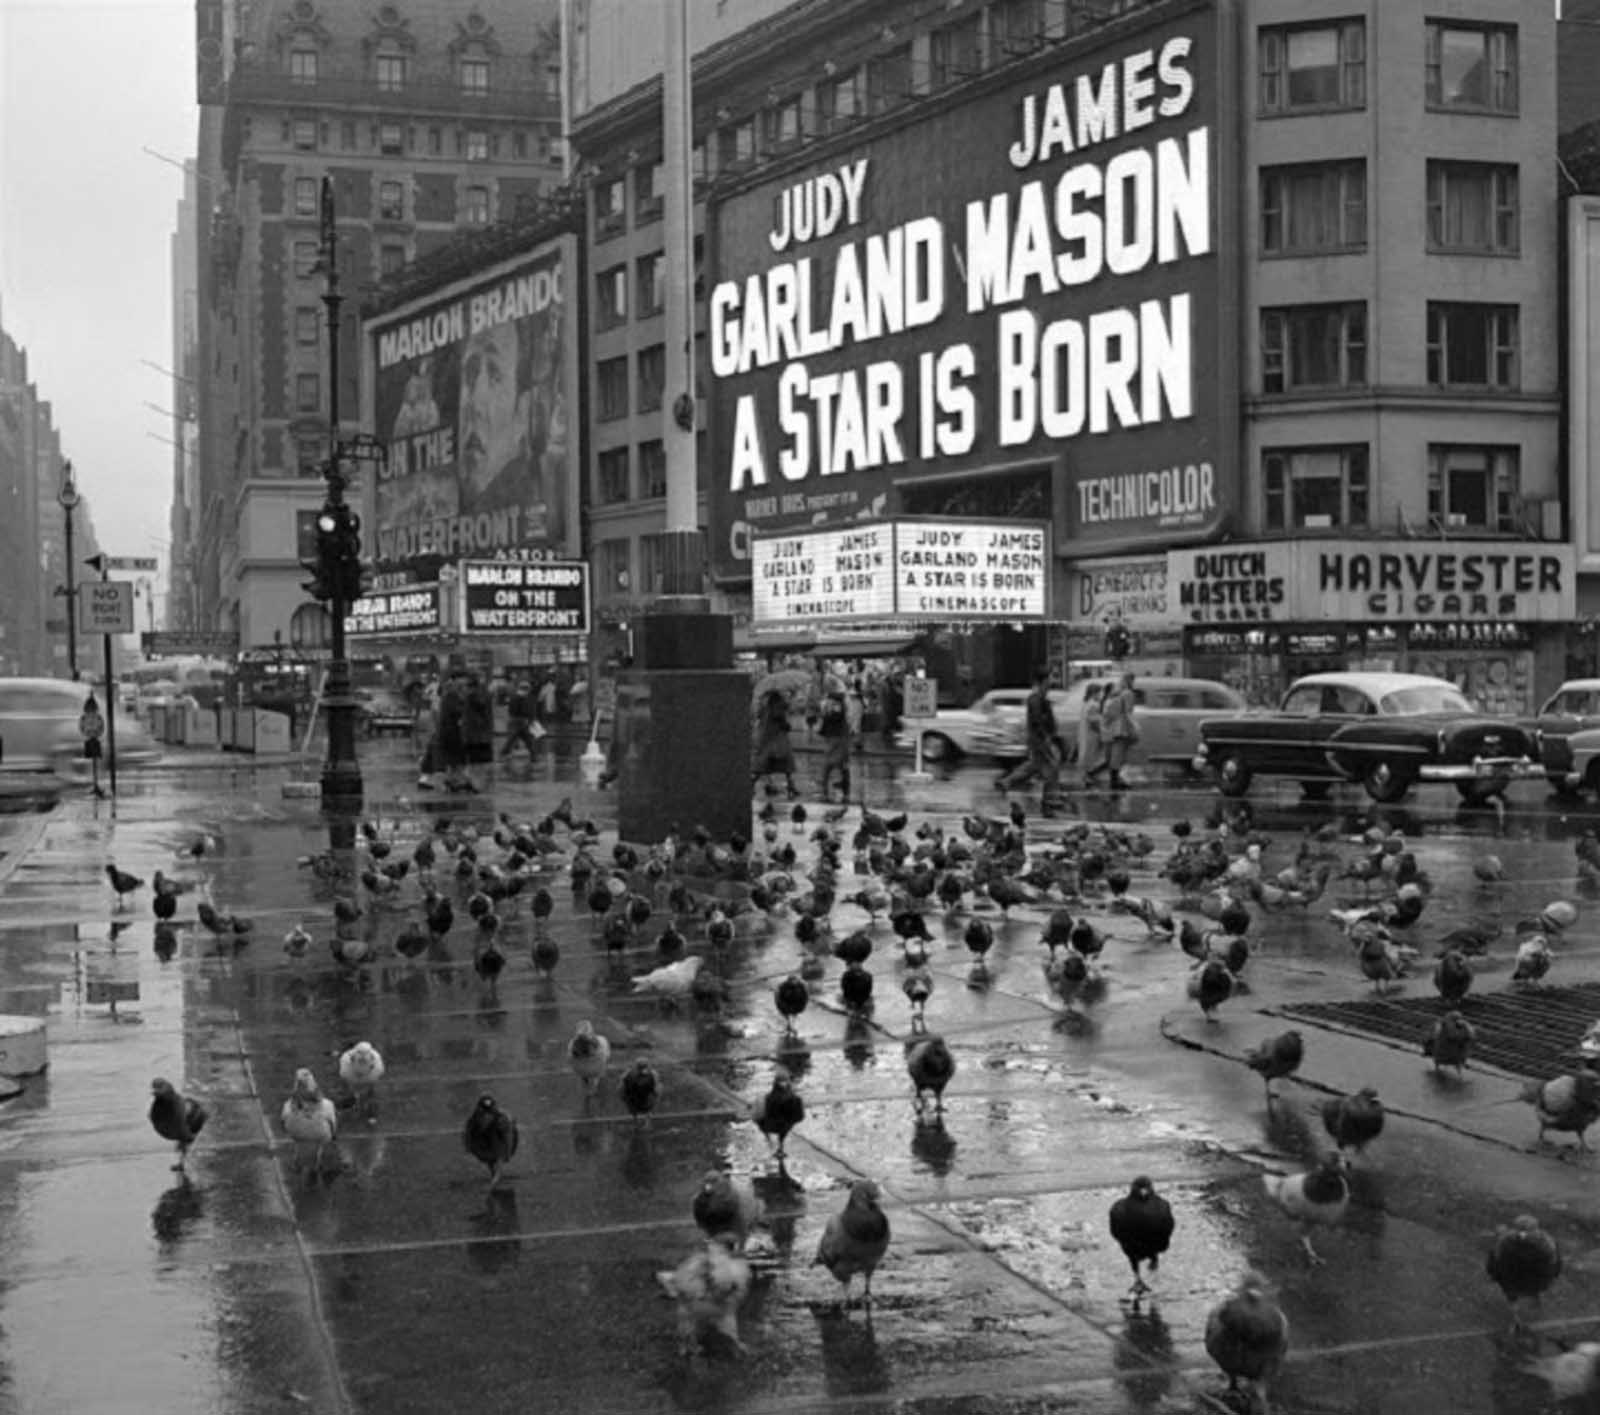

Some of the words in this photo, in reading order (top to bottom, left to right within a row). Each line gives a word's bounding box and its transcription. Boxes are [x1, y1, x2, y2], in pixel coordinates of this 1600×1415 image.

[1010, 37, 1192, 168] JAMES
[769, 159, 868, 251] JUDY
[710, 216, 944, 378] GARLAND
[966, 126, 1210, 313] MASON
[379, 302, 464, 370] MARLON
[730, 395, 767, 491] A
[920, 343, 976, 459] IS
[413, 429, 453, 473] THE
[1077, 463, 1215, 525] TECHNICOLOR
[378, 504, 520, 562] WATERFRONT
[838, 531, 878, 553] JAMES
[916, 531, 963, 547] JUDY
[988, 533, 1042, 550] JAMES
[494, 548, 557, 561] ASTOR
[763, 558, 815, 579] GARLAND
[836, 552, 883, 573] MASON
[900, 551, 978, 567] GARLAND
[986, 553, 1043, 570] MASON
[1195, 551, 1265, 579] DUTCH
[467, 567, 522, 585] MARLON
[526, 568, 580, 586] BRANDO
[772, 580, 779, 597] A
[784, 578, 812, 597] STAR
[822, 576, 833, 594] IS
[841, 573, 873, 593] BORN
[906, 571, 916, 586] A
[924, 571, 965, 587] STAR
[971, 573, 988, 587] IS
[993, 573, 1035, 590] BORN
[1319, 553, 1562, 593] HARVESTER
[93, 588, 119, 601] NO
[495, 590, 519, 606] ON
[521, 590, 556, 606] THE
[919, 596, 1027, 611] CINEMASCOPE
[1180, 578, 1284, 605] MASTERS
[785, 600, 855, 617] CINEMASCOPE
[1367, 593, 1517, 615] CIGARS
[471, 608, 580, 626] WATERFRONT
